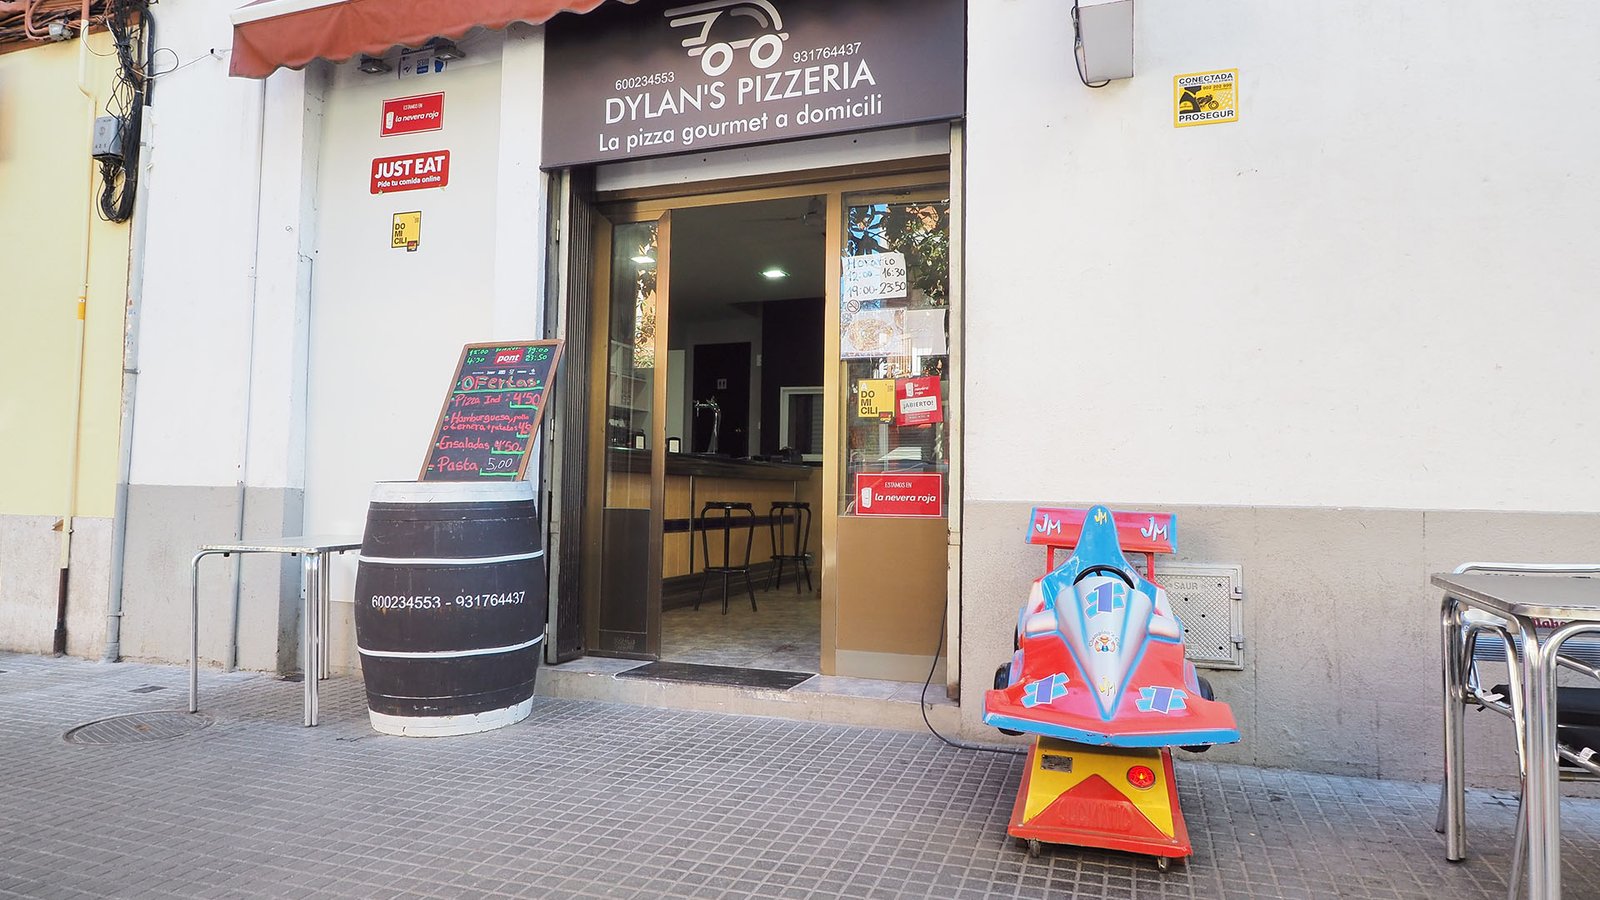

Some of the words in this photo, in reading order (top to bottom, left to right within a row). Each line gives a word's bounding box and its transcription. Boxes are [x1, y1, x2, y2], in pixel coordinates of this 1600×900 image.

[793, 42, 861, 63] 931764437
[615, 71, 675, 90] 600234553
[1179, 73, 1233, 84] CONECTADA
[605, 81, 726, 124] DYLAN'S
[738, 59, 876, 105] PIZZERIA
[403, 113, 425, 121] nevera
[426, 110, 439, 119] roja
[1179, 110, 1234, 122] PROSEGUR
[600, 134, 620, 151] La
[627, 129, 675, 152] pizza
[682, 114, 768, 144] gourmet
[776, 114, 788, 128] a
[796, 94, 882, 125] domicili
[375, 160, 413, 178] JUST
[415, 156, 445, 174] EAT
[882, 267, 905, 278] 16:30
[497, 354, 520, 363] pont
[861, 398, 871, 406] MI
[861, 406, 878, 414] CILI
[438, 436, 490, 450] Ensaladas
[438, 456, 478, 472] Pasta
[486, 458, 513, 471] 5,00
[875, 493, 883, 501] la
[918, 494, 936, 504] roja
[1036, 514, 1061, 536] JM
[1094, 508, 1107, 525] JM
[1140, 516, 1169, 541] JM
[1173, 582, 1198, 590] SAUR
[372, 595, 441, 608] 600234553
[456, 591, 525, 608] 931764437
